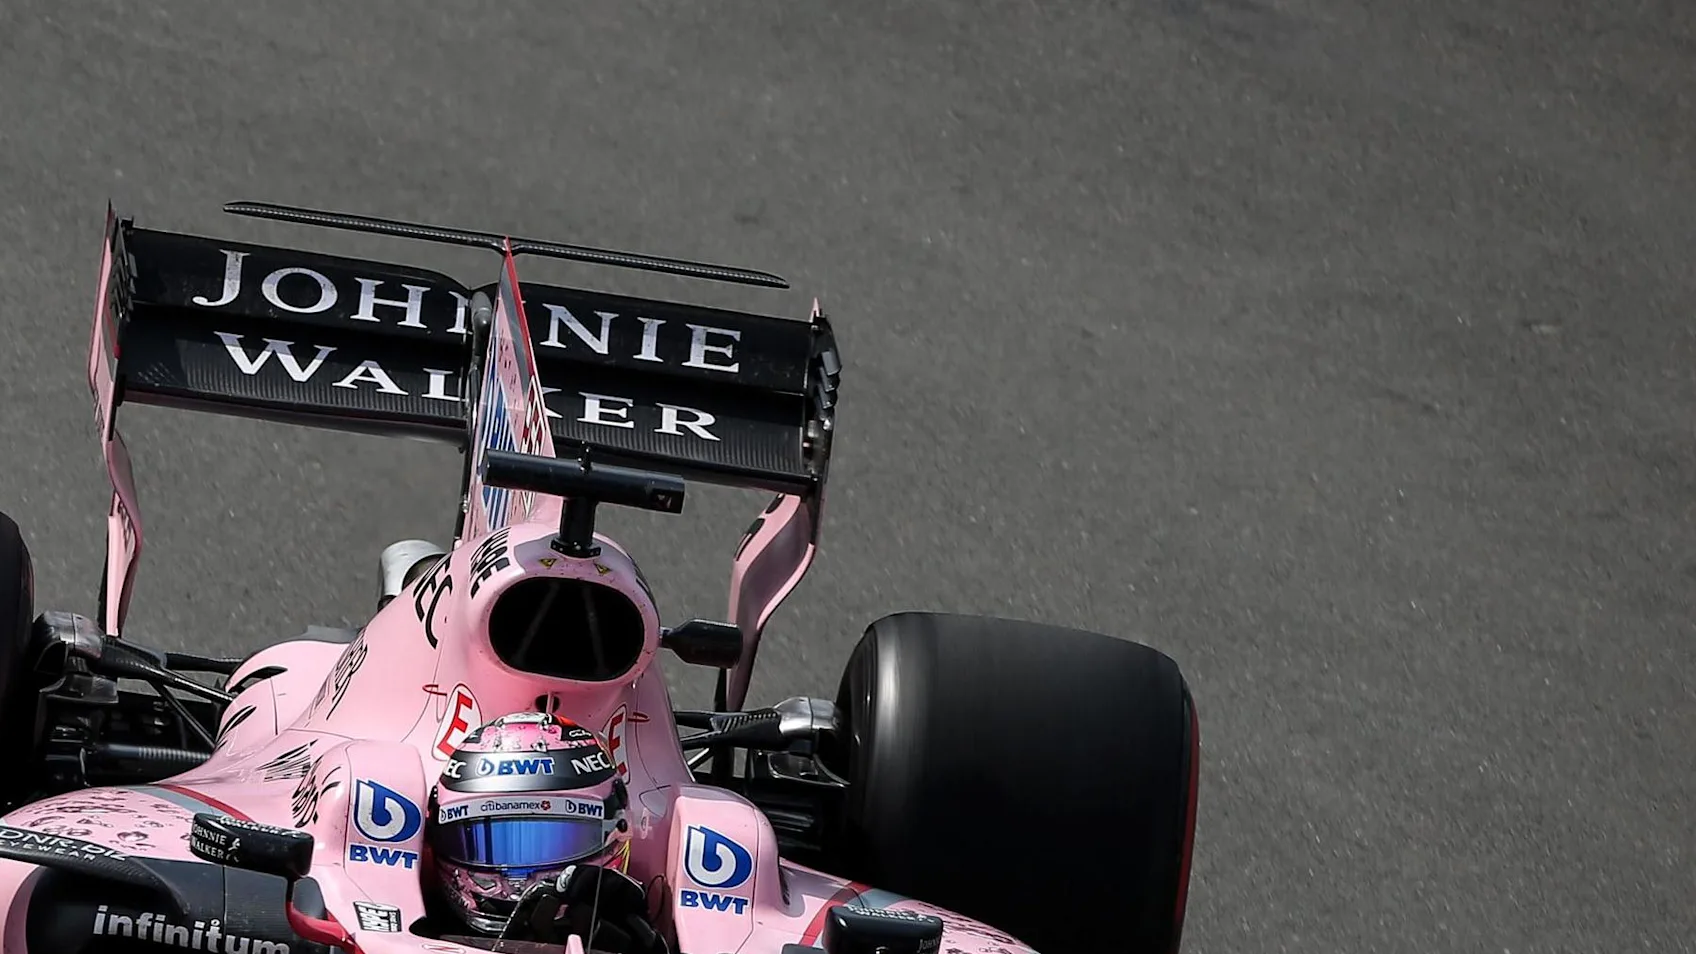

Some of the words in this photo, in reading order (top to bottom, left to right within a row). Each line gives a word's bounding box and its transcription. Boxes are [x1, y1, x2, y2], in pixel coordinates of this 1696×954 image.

[213, 331, 721, 441] WALER
[445, 759, 466, 778] EC
[497, 759, 554, 775] BWT
[571, 752, 613, 775] NEC
[447, 805, 469, 820] BWT
[481, 801, 541, 812] citibanamex
[578, 805, 603, 817] BWT
[350, 844, 418, 869] BWT
[681, 890, 748, 915] BWT
